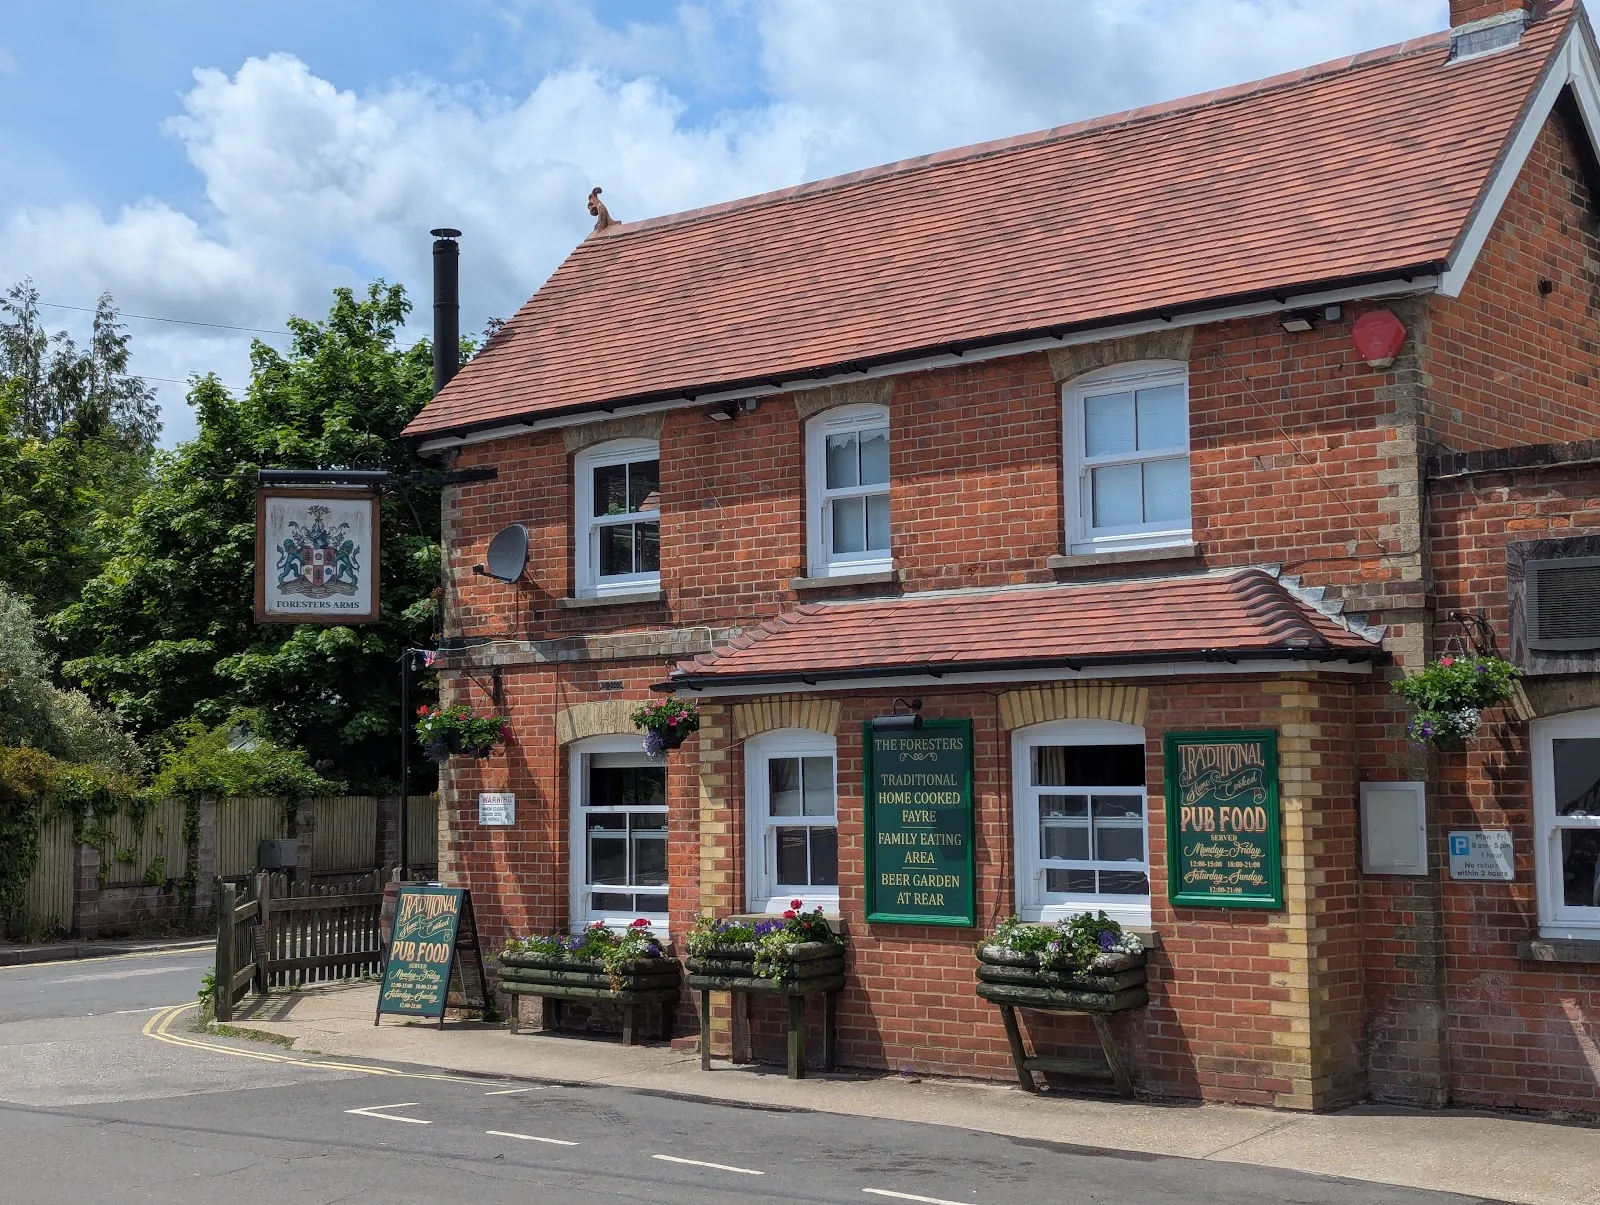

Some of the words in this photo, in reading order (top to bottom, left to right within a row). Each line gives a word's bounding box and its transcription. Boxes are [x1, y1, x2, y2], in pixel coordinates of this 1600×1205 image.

[277, 600, 331, 608] FORESTERS
[333, 601, 360, 609] ARMS
[875, 739, 897, 751] THE
[900, 737, 963, 751] FORESTERS
[1178, 743, 1265, 780] TRADITIONAL
[880, 773, 958, 786] TRADITIONAL
[1186, 779, 1211, 801] Home
[1219, 771, 1258, 797] Cooked
[878, 791, 912, 804] HOME
[914, 791, 961, 804] COOKED
[902, 810, 937, 823] FAYRE
[1180, 806, 1216, 832] PUB
[1219, 806, 1267, 832] FOOD
[878, 832, 918, 845] FAMILY
[920, 833, 962, 846] EATING
[1210, 834, 1238, 842] SERVED
[1497, 833, 1507, 841] Fri
[904, 851, 935, 864] AREA
[881, 873, 911, 886] BEER
[913, 874, 960, 888] GARDEN
[896, 892, 912, 905] AT
[914, 892, 945, 906] REAR
[401, 894, 458, 921] TRADITIONAL
[390, 941, 416, 961] PUB
[416, 942, 450, 963] FOOD
